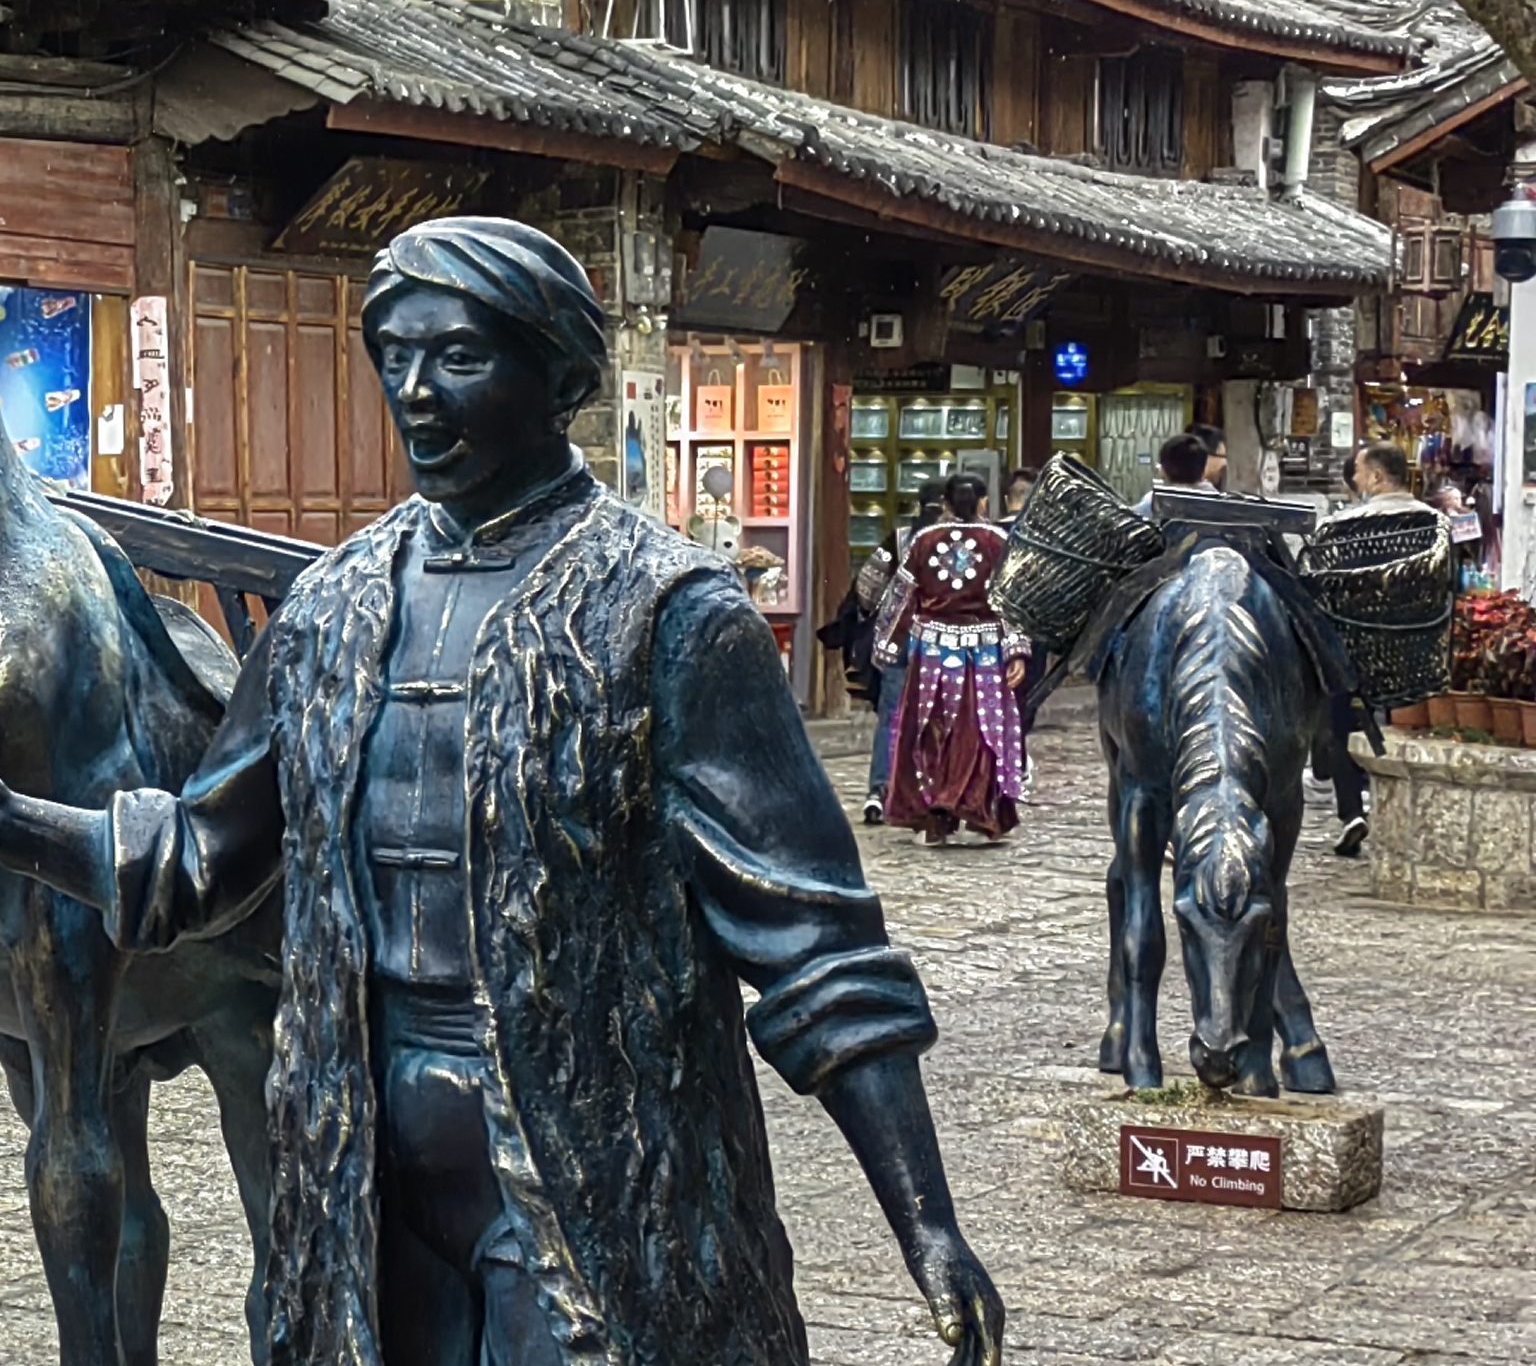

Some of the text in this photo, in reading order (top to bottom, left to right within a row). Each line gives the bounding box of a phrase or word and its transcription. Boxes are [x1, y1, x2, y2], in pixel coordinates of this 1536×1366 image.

[1184, 1144, 1271, 1172] 严禁攀爬
[1189, 1174, 1265, 1196] No Climbing
